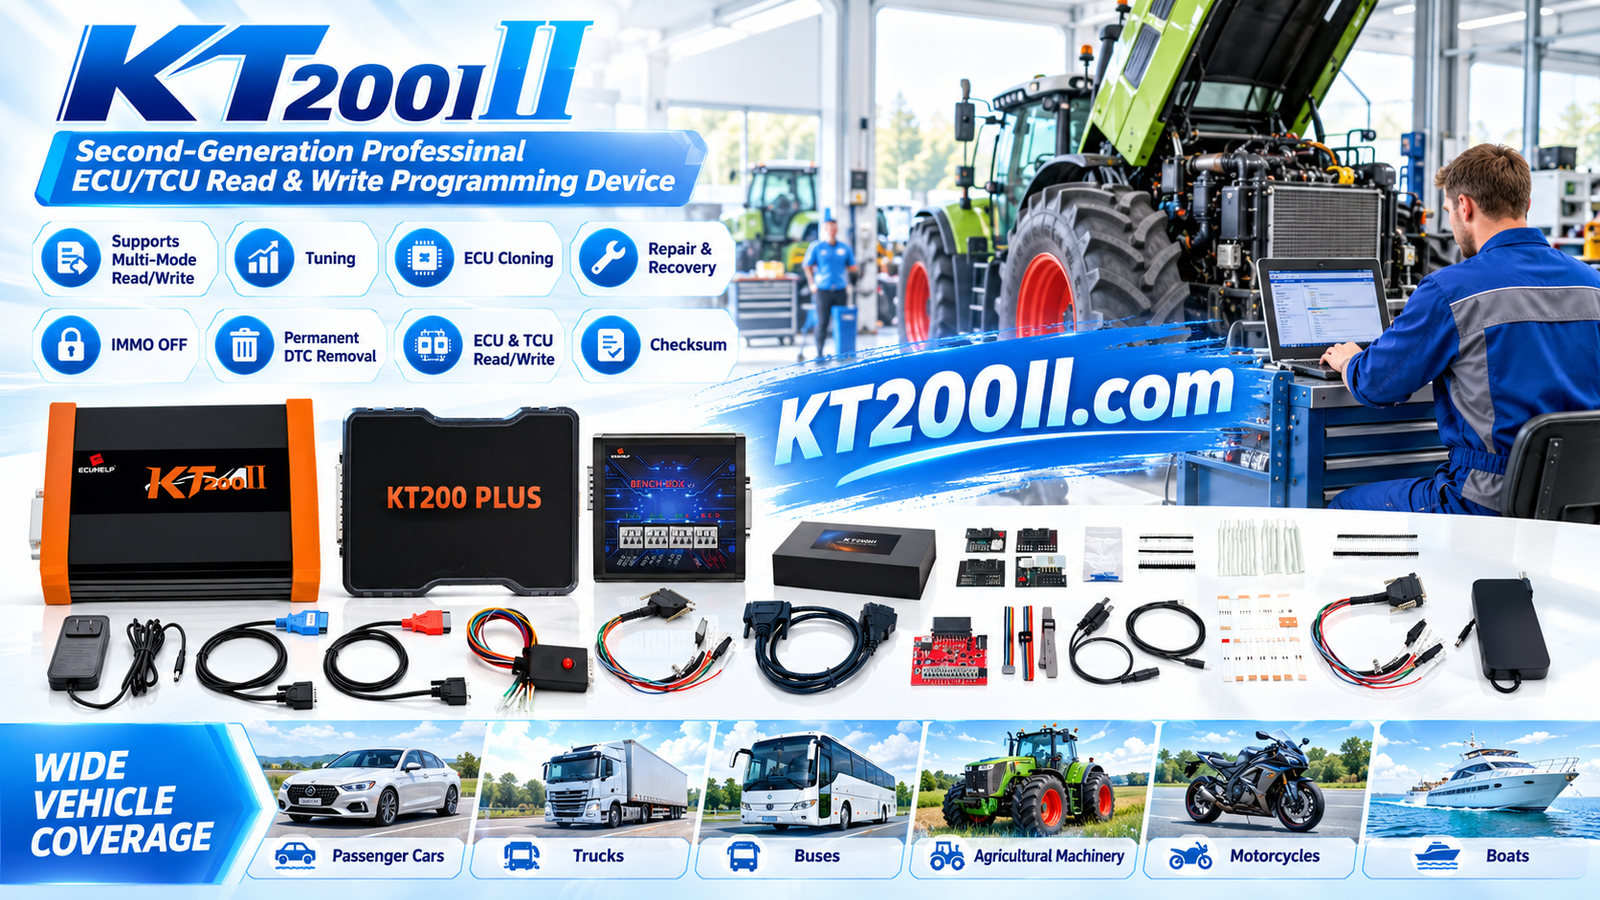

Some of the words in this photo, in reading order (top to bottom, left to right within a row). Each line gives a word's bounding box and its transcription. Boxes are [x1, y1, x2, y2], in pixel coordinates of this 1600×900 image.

[145, 464, 267, 500] KT200II
[387, 485, 467, 509] KT200
[475, 485, 542, 509] PLUS
